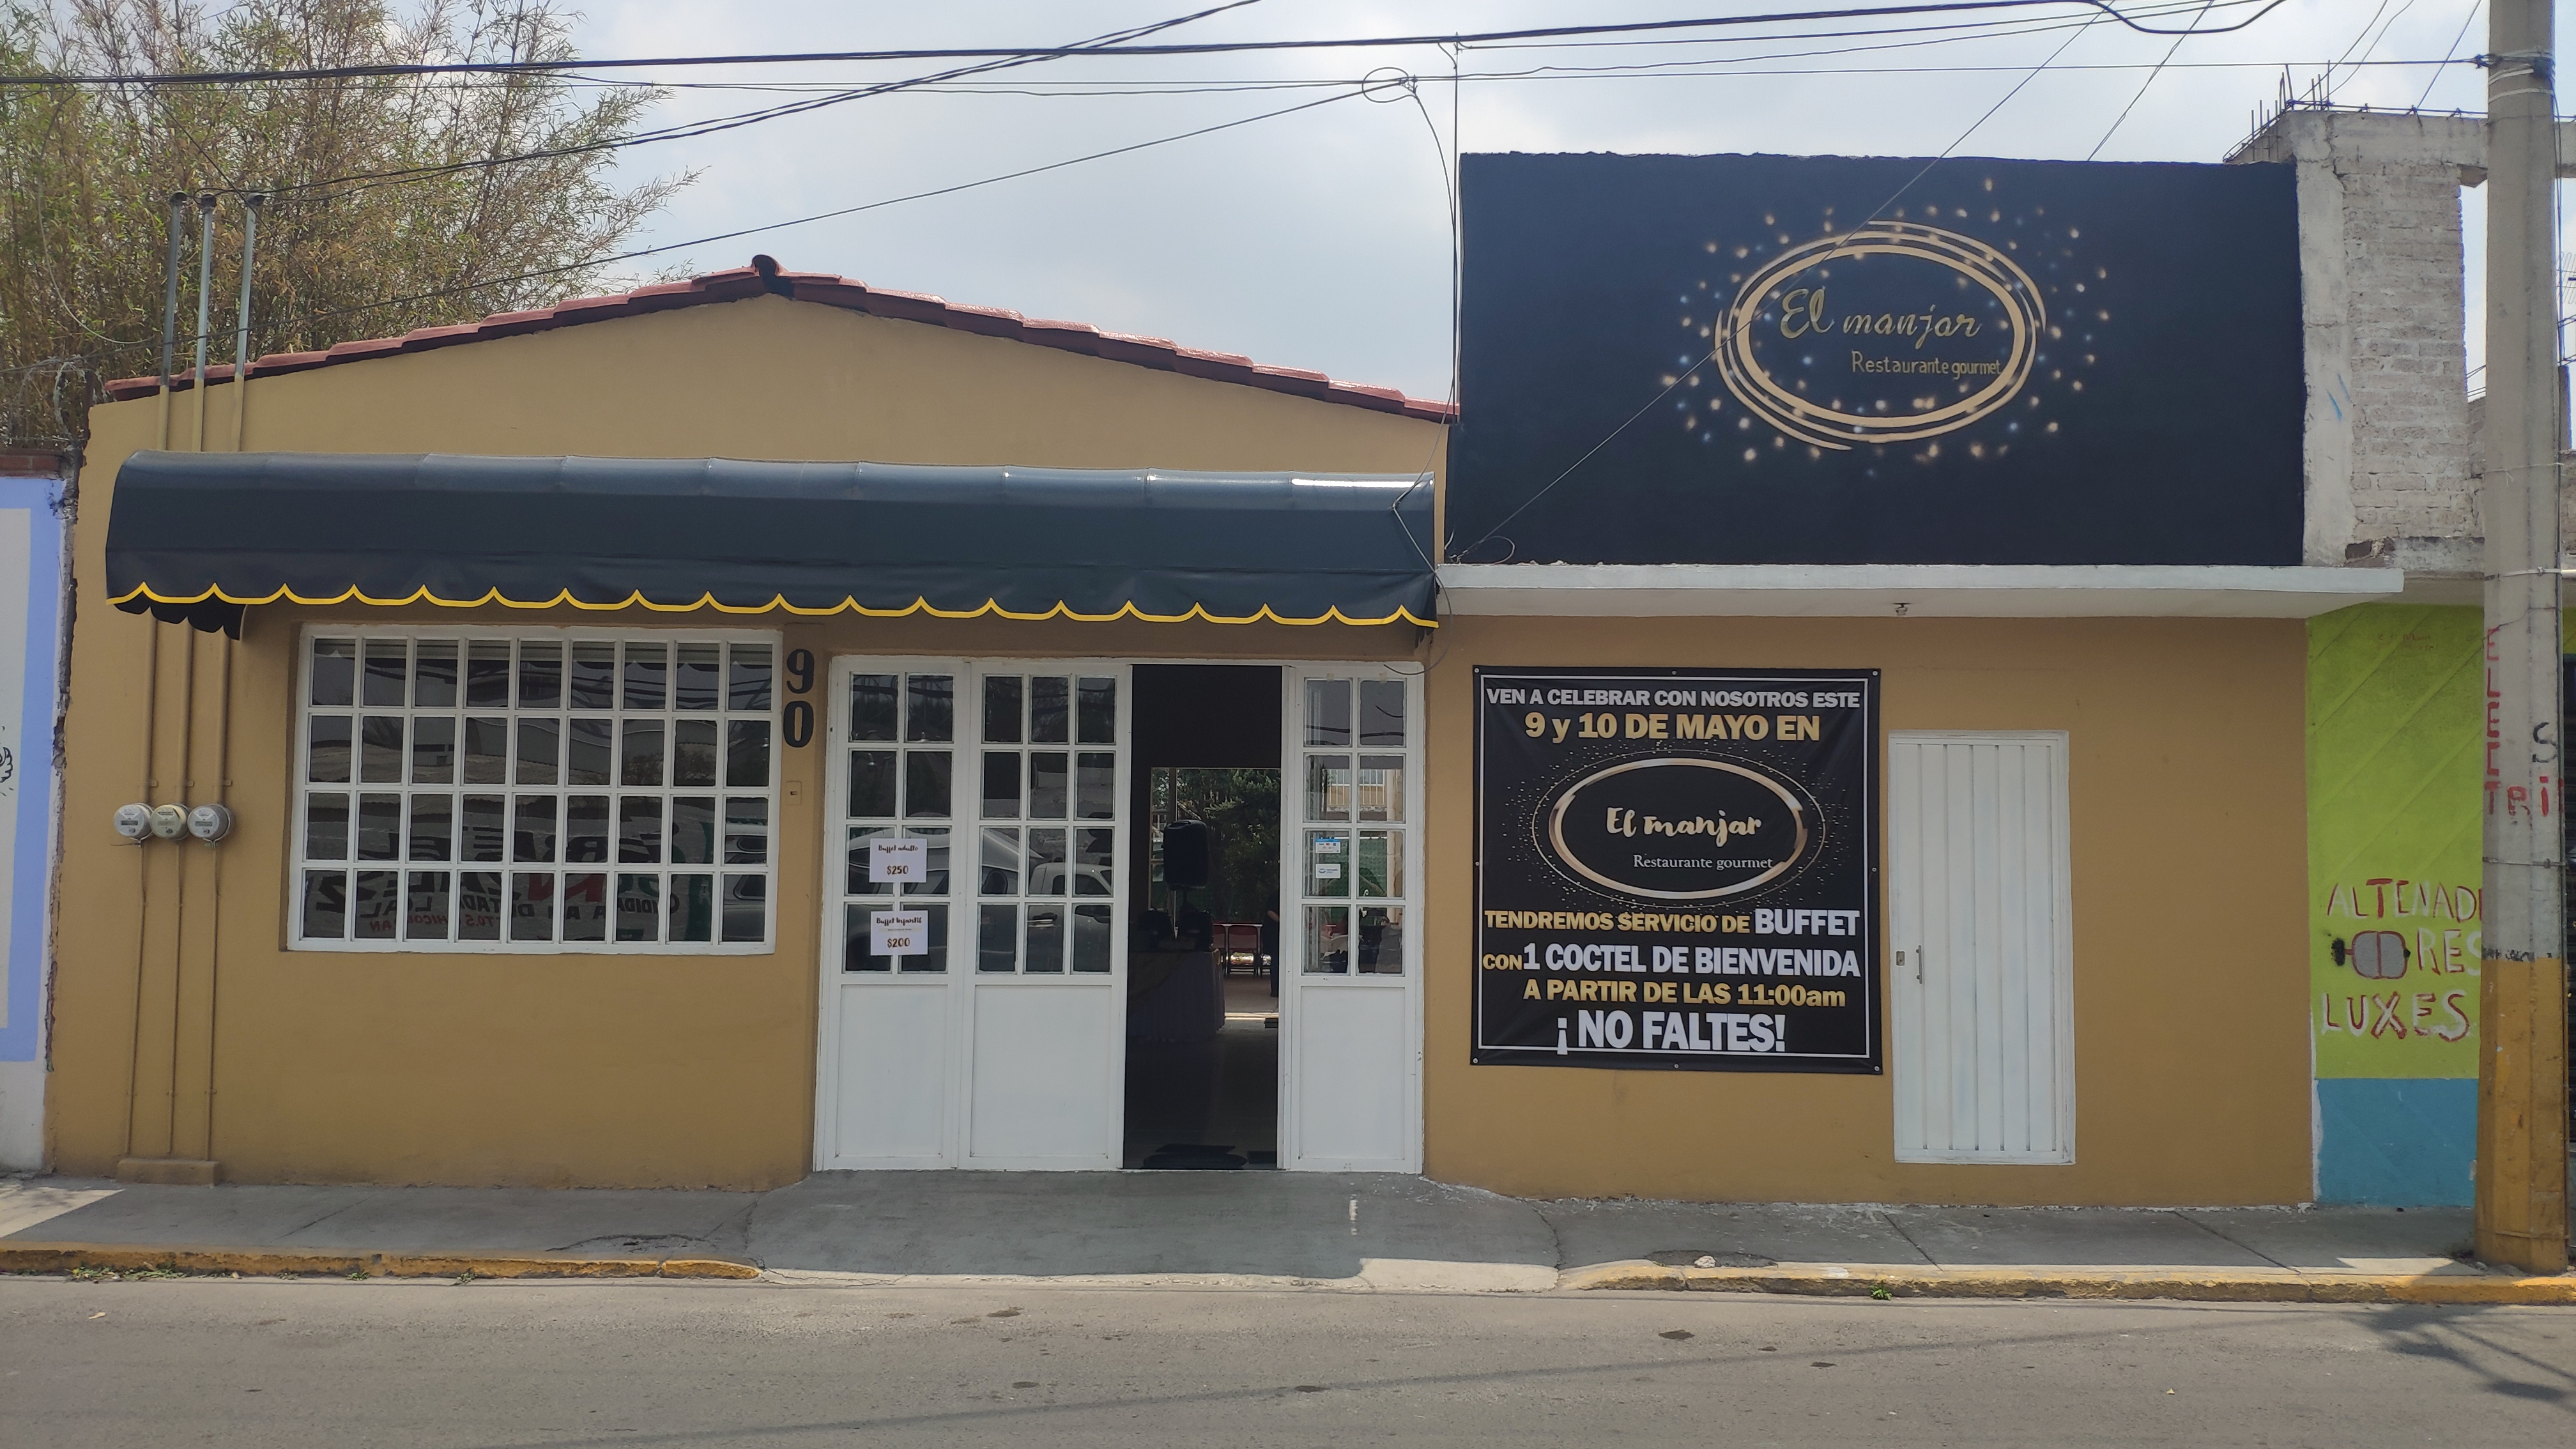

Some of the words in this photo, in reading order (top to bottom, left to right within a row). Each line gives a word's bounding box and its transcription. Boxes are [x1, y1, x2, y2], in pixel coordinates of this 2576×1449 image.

[1780, 286, 1834, 338] El
[1843, 305, 1981, 348] manjar
[1851, 351, 1949, 374] Restaurante
[1952, 359, 2001, 380] gourmet
[1486, 688, 1526, 704] VEN
[1529, 689, 1544, 705] A
[1547, 689, 1650, 706] CELEBRAR
[1655, 690, 1698, 707] CON
[1701, 691, 1809, 708] NOSOTROS
[1813, 692, 1860, 709] ESTE
[1525, 712, 1545, 737] 9
[1552, 719, 1570, 743] y
[1579, 712, 1617, 739] 10
[1626, 714, 1668, 739] DE
[1676, 714, 1768, 740] MAYO
[1777, 715, 1820, 741] EN
[1607, 807, 1637, 837] El
[1643, 809, 1761, 847] manjar
[878, 845, 896, 854] Buffet
[1634, 854, 1712, 869] Restaurante
[1716, 856, 1773, 870] gourmet
[887, 865, 908, 876] $250
[877, 917, 894, 926] Buffet
[1485, 910, 1614, 931] TENDREMOS
[1617, 913, 1717, 933] SERVICIO
[1722, 915, 1749, 933] DE
[1754, 908, 1860, 936] BUFFET
[887, 937, 910, 948] $200
[1483, 954, 1522, 970] CON
[1523, 942, 1540, 970] 1
[1545, 943, 1646, 972] COCTEL
[1652, 946, 1689, 974] DE
[1695, 947, 1860, 977] BIENVENIDA
[1523, 979, 1540, 1000] A
[1547, 979, 1637, 1002] PARTIR
[1643, 982, 1678, 1003] DE
[1683, 983, 1731, 1005] LAS
[1737, 984, 1845, 1008] 11:00am
[2321, 990, 2471, 1043] LUXES
[1643, 1011, 1786, 1052] FALTES!
